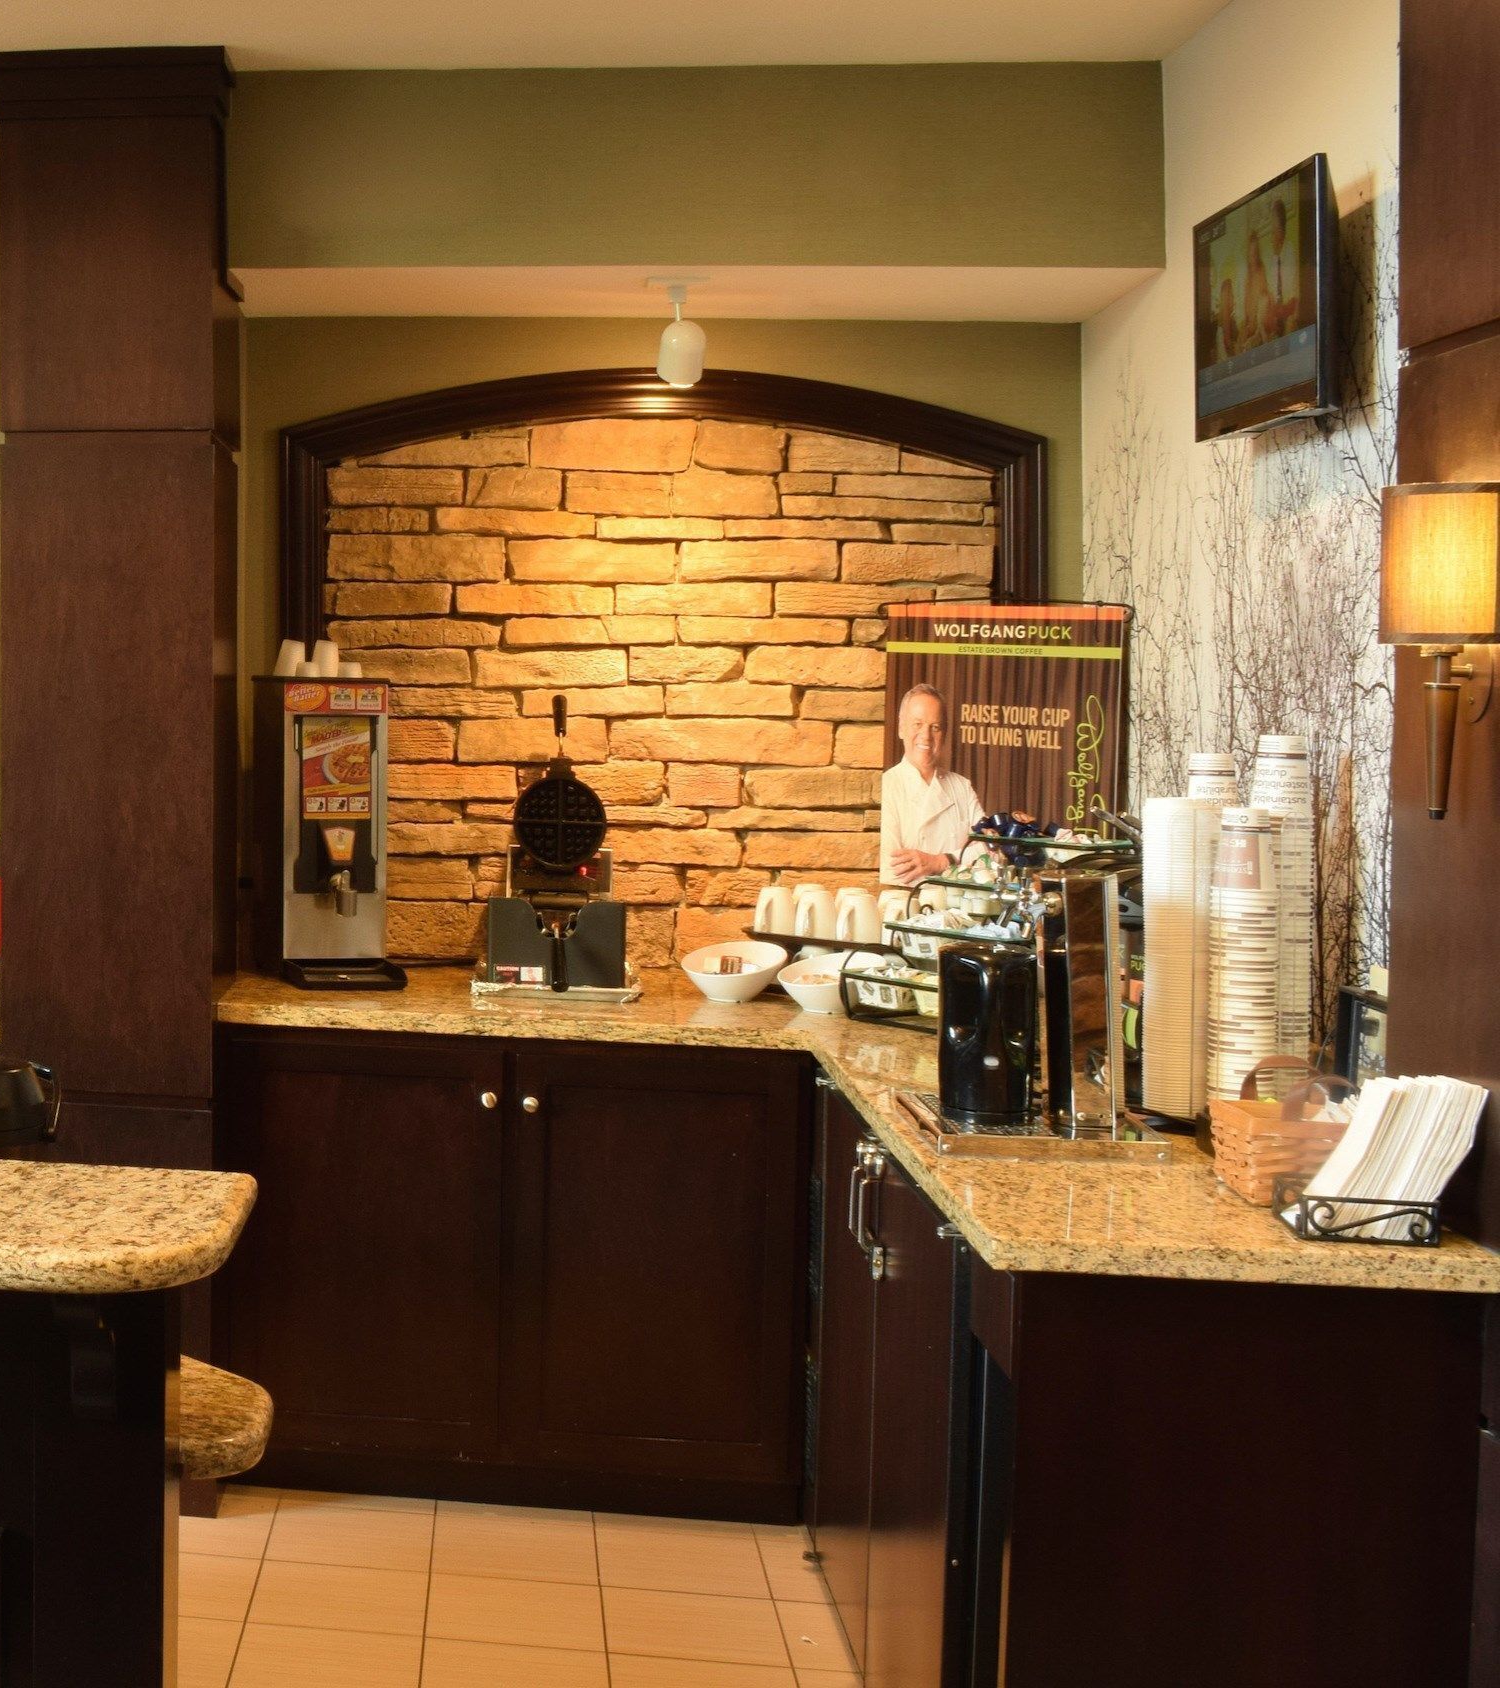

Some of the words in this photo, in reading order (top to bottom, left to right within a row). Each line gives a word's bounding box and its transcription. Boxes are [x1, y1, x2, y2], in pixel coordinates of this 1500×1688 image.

[958, 646, 984, 654] ESTATE
[985, 647, 1012, 655] GROWN
[961, 703, 999, 724] RAISE
[1002, 706, 1039, 726] YOUR
[1041, 708, 1071, 728] CUP
[960, 725, 977, 744] TO
[980, 726, 1023, 747] LIVING
[1025, 728, 1062, 750] WELL
